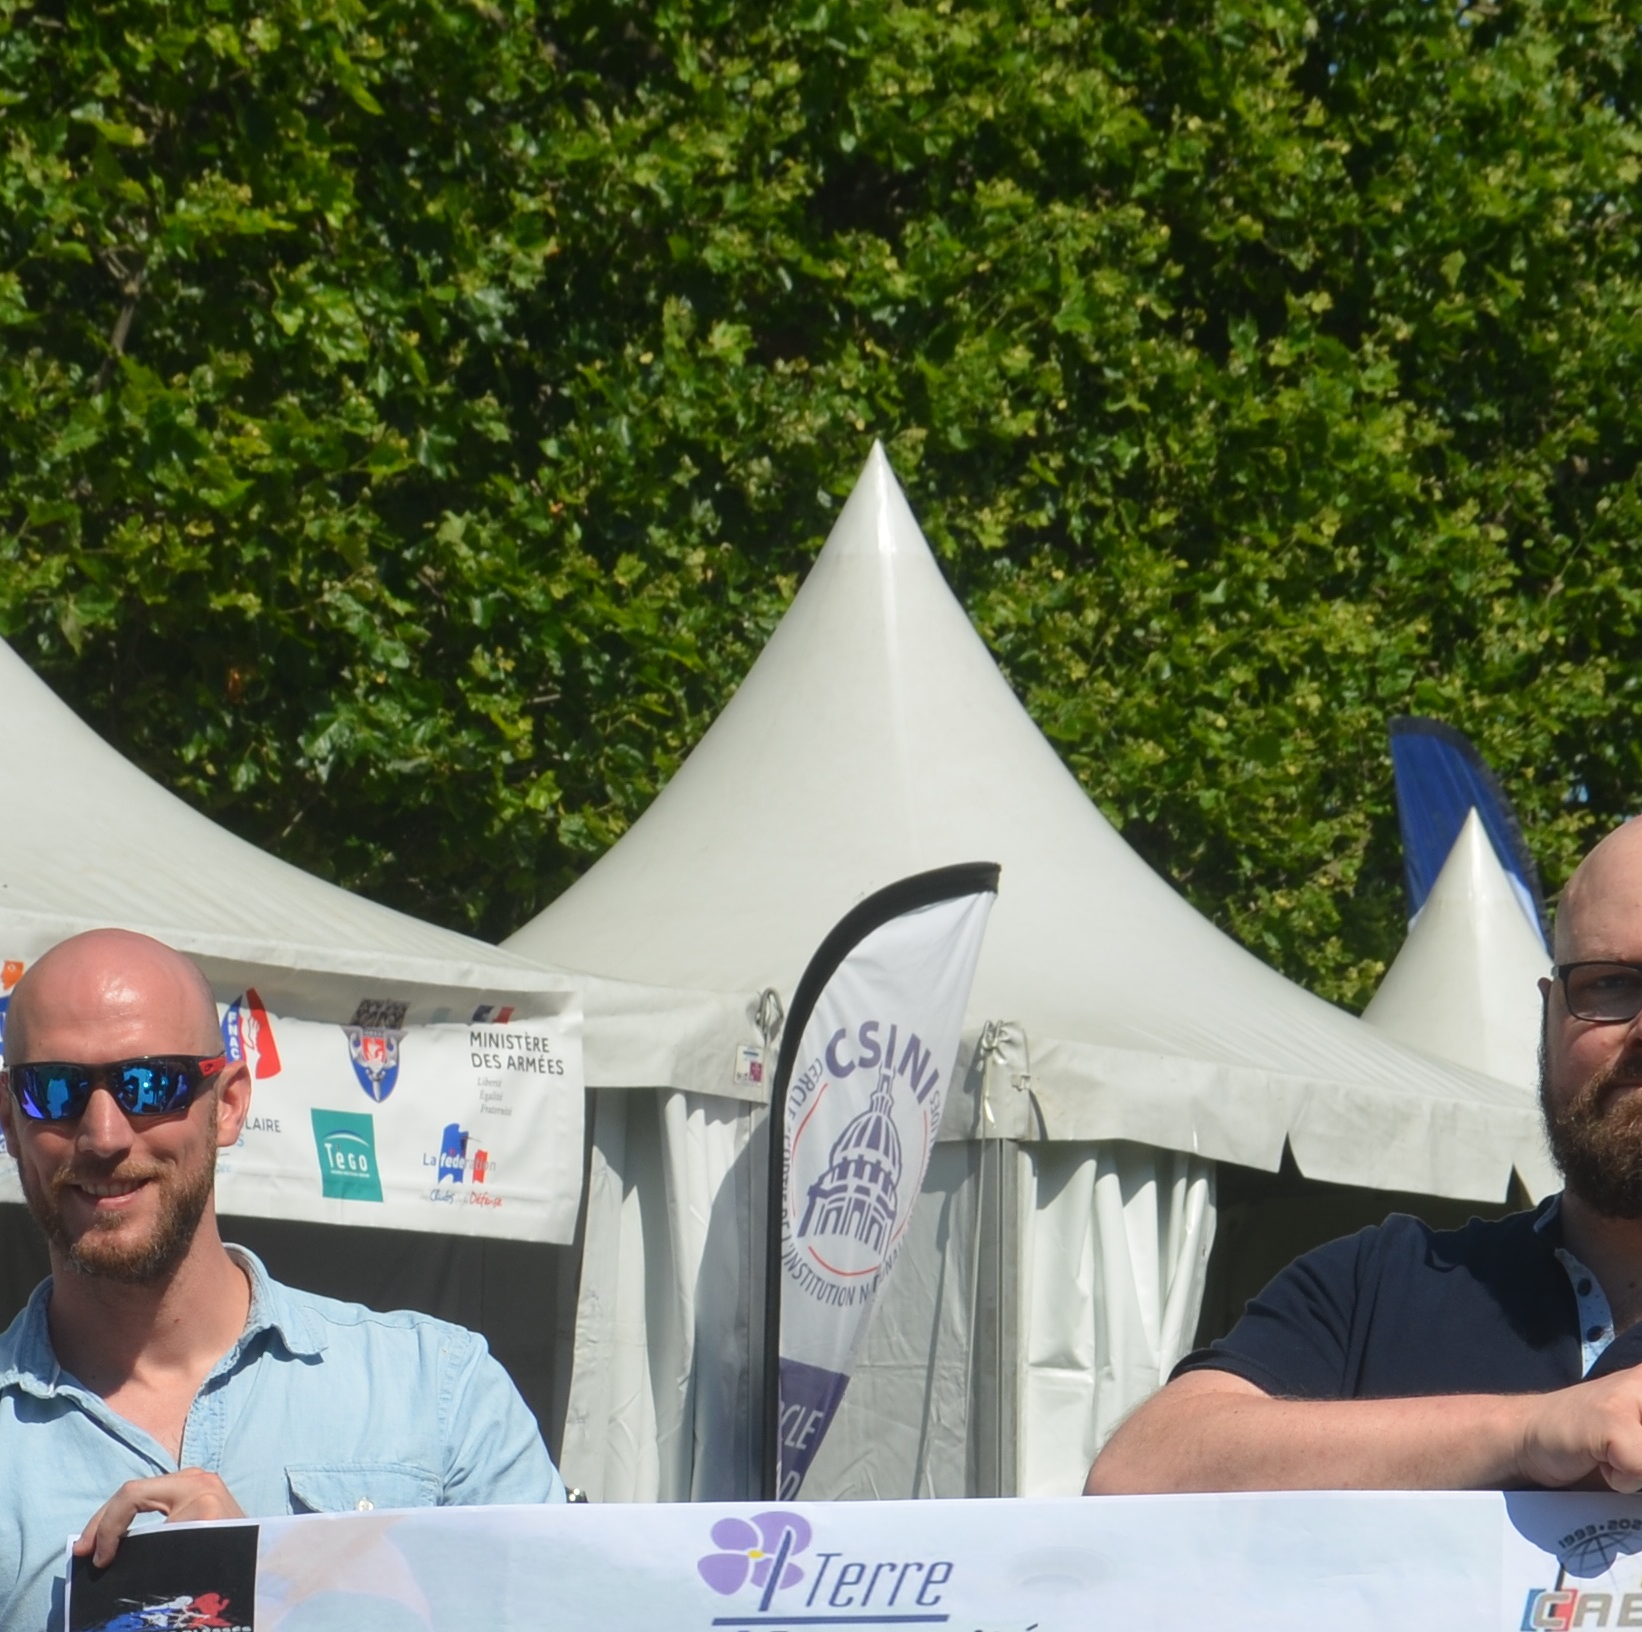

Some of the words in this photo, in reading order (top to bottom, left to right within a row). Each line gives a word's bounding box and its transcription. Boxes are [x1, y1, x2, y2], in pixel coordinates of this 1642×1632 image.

[470, 1031, 550, 1053] MINISTÈRE
[471, 1053, 502, 1068] DES
[507, 1055, 565, 1075] ARMÉES
[825, 1020, 940, 1105] CSINI
[244, 1118, 281, 1133] LAIRE
[423, 1153, 437, 1167] La
[805, 1552, 955, 1608] Terre
